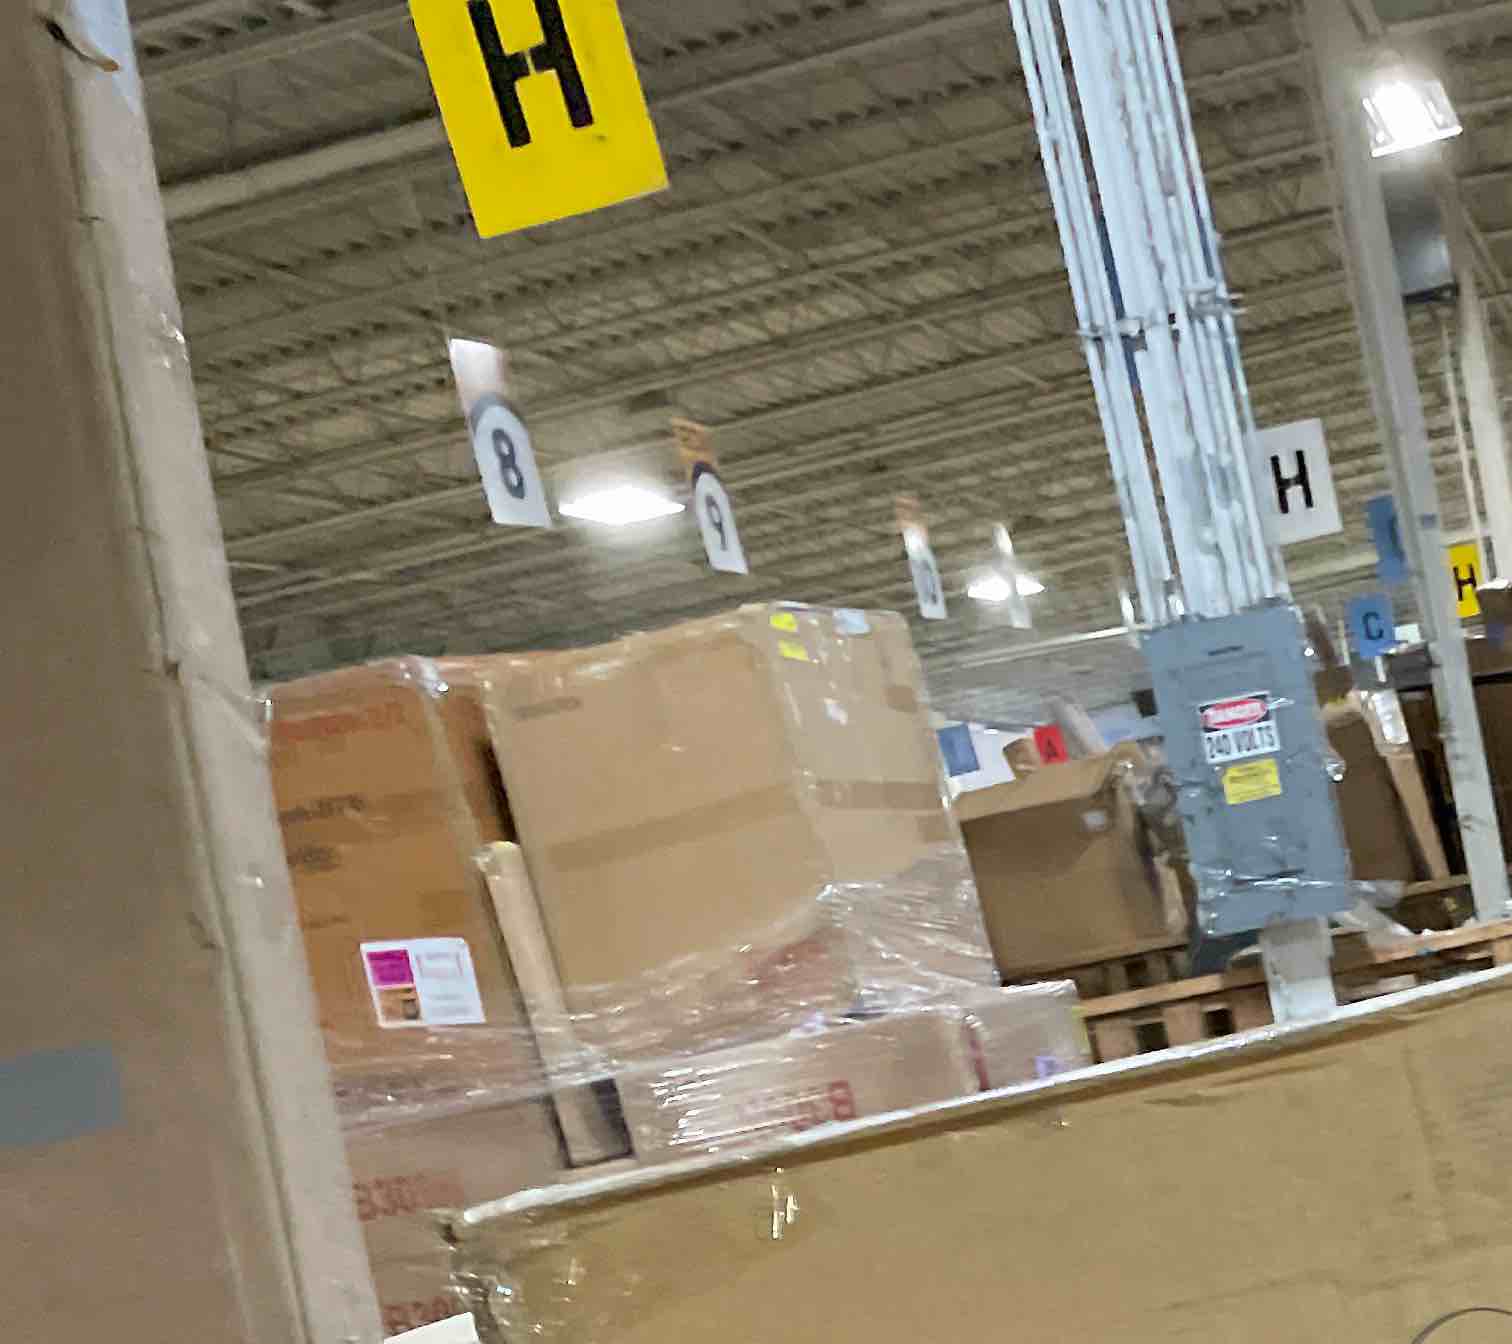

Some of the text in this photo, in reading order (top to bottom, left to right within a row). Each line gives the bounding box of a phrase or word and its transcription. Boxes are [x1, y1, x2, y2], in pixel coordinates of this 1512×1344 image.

[468, 0, 593, 148] H
[491, 427, 526, 500] 8
[1270, 449, 1314, 514] H
[704, 494, 729, 551] 9
[1452, 564, 1477, 602] H
[1361, 610, 1384, 642] C
